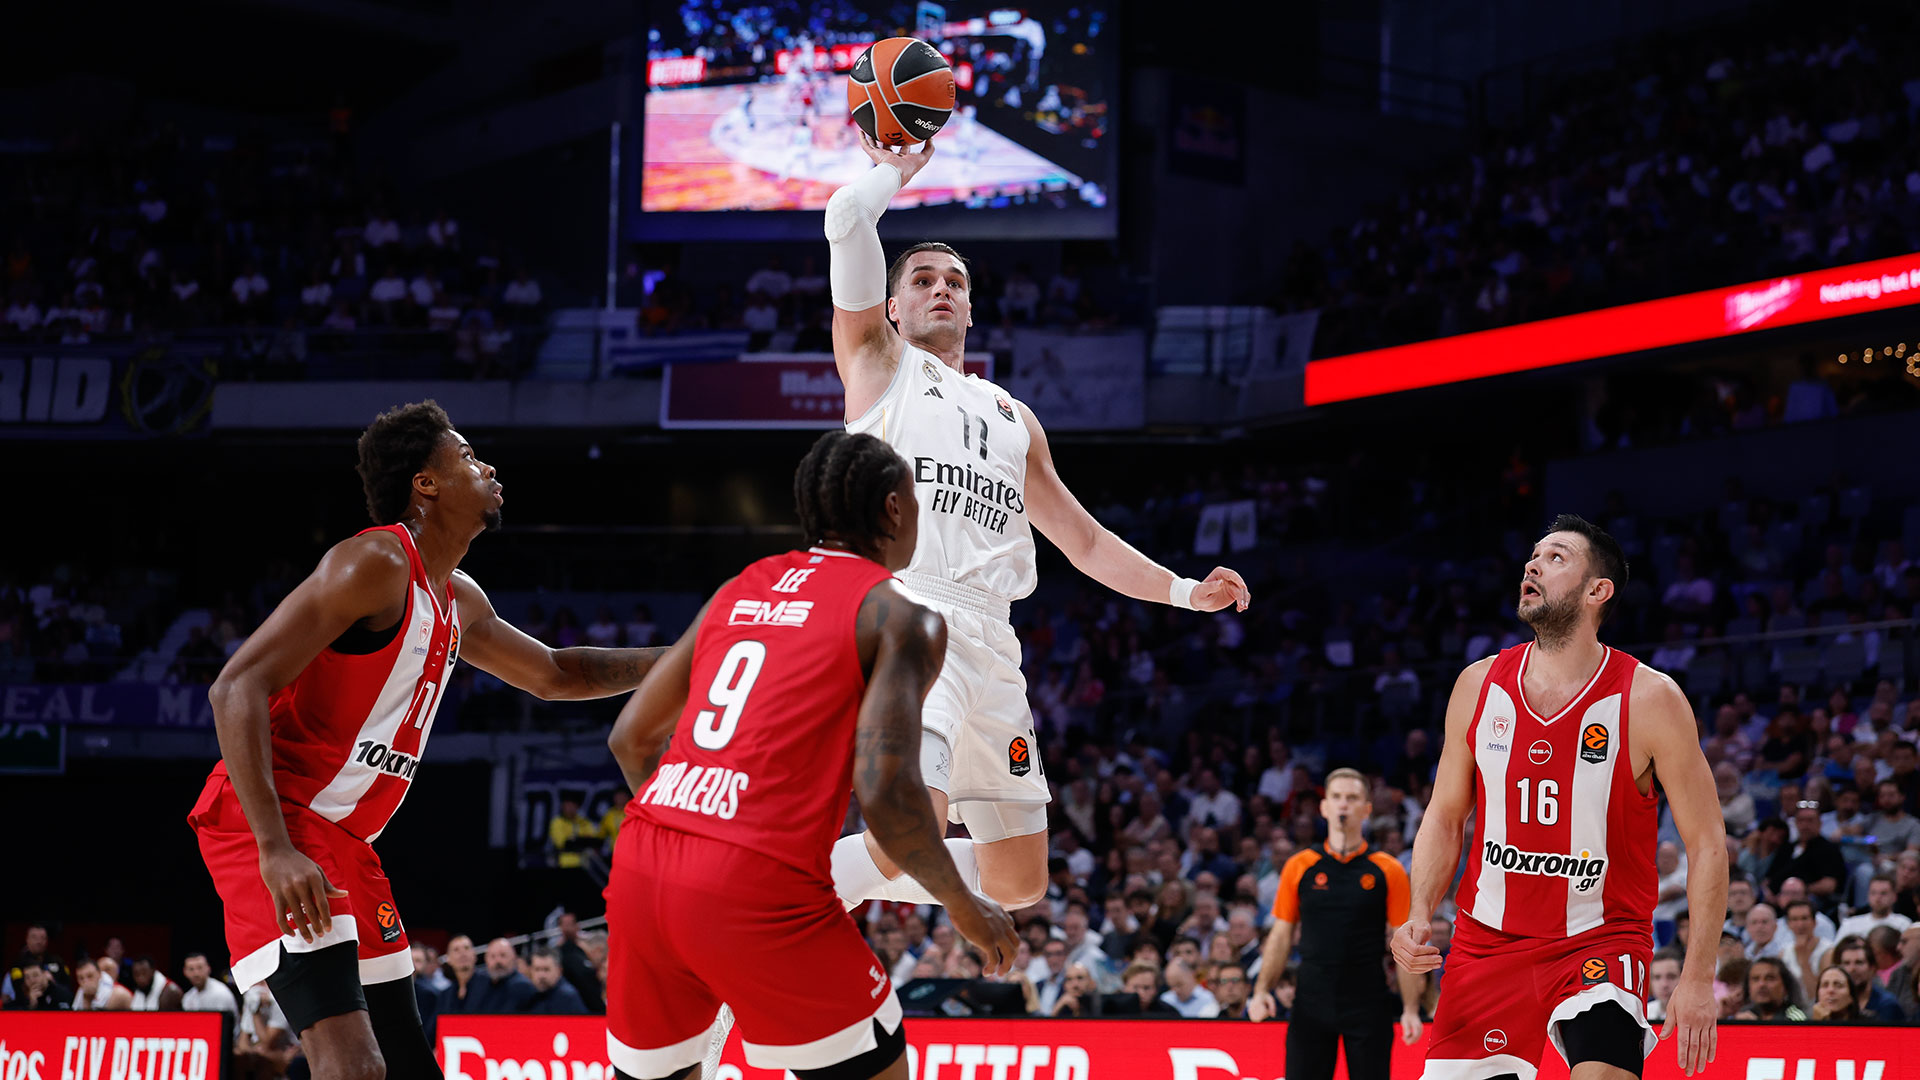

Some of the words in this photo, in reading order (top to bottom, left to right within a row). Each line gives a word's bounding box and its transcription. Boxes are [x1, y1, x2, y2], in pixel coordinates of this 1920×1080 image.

[957, 405, 989, 460] 11
[914, 457, 1024, 514] Emirates
[932, 489, 961, 514] FLY
[964, 496, 1008, 535] BETTER
[728, 599, 815, 624] FMS
[692, 640, 767, 751] 9
[640, 761, 749, 820] PIRAEUS
[1516, 777, 1560, 826] 16
[1485, 840, 1605, 877] 100xronia
[1575, 876, 1599, 892] .gr
